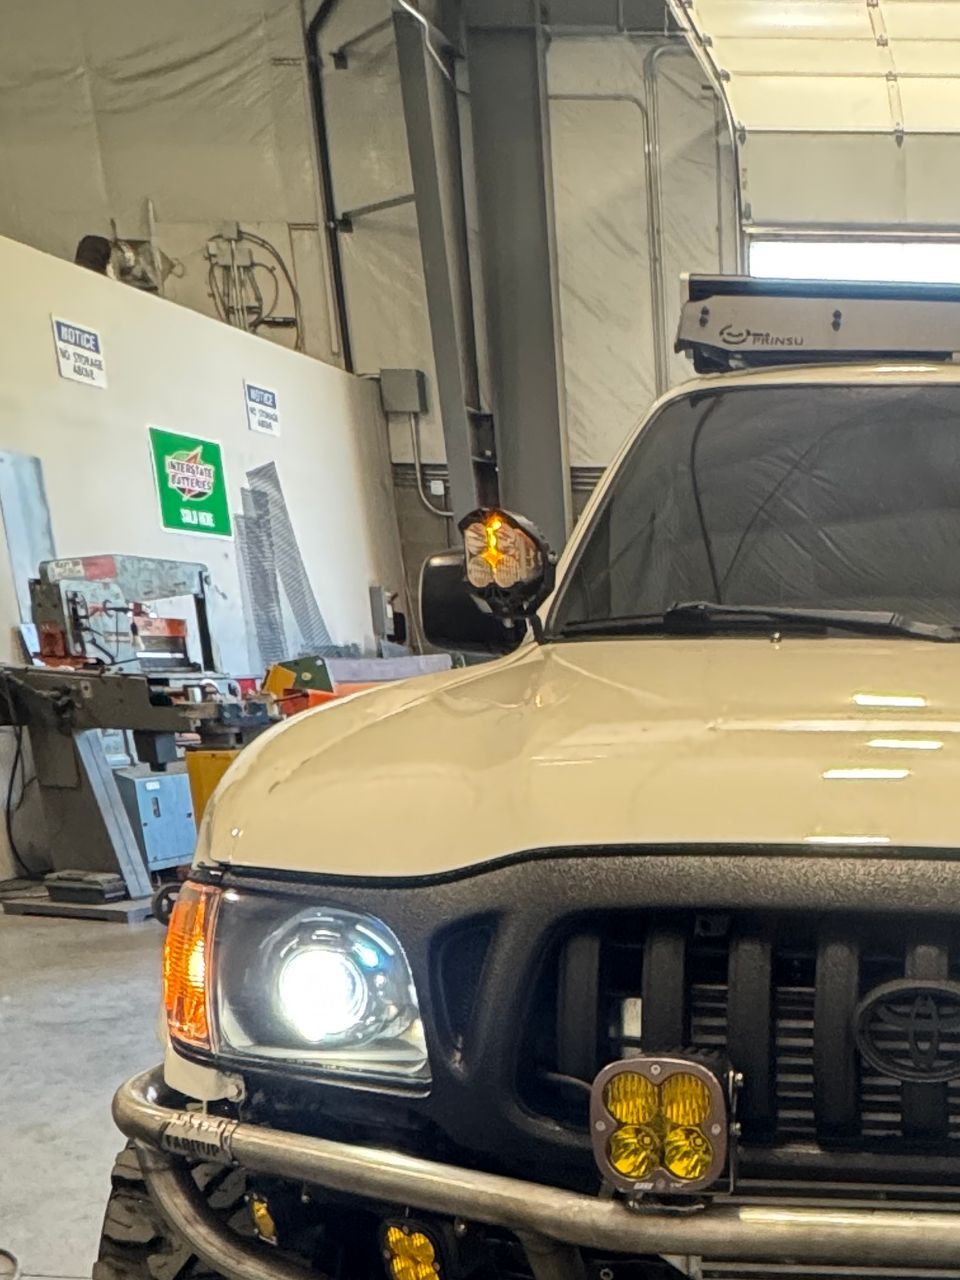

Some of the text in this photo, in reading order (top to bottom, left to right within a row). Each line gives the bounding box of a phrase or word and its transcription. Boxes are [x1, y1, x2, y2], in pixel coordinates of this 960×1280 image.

[60, 324, 97, 351] NOTICE
[751, 332, 804, 346] PRINSU
[167, 460, 213, 478] INTERSTATE
[171, 472, 212, 491] BATTERIES
